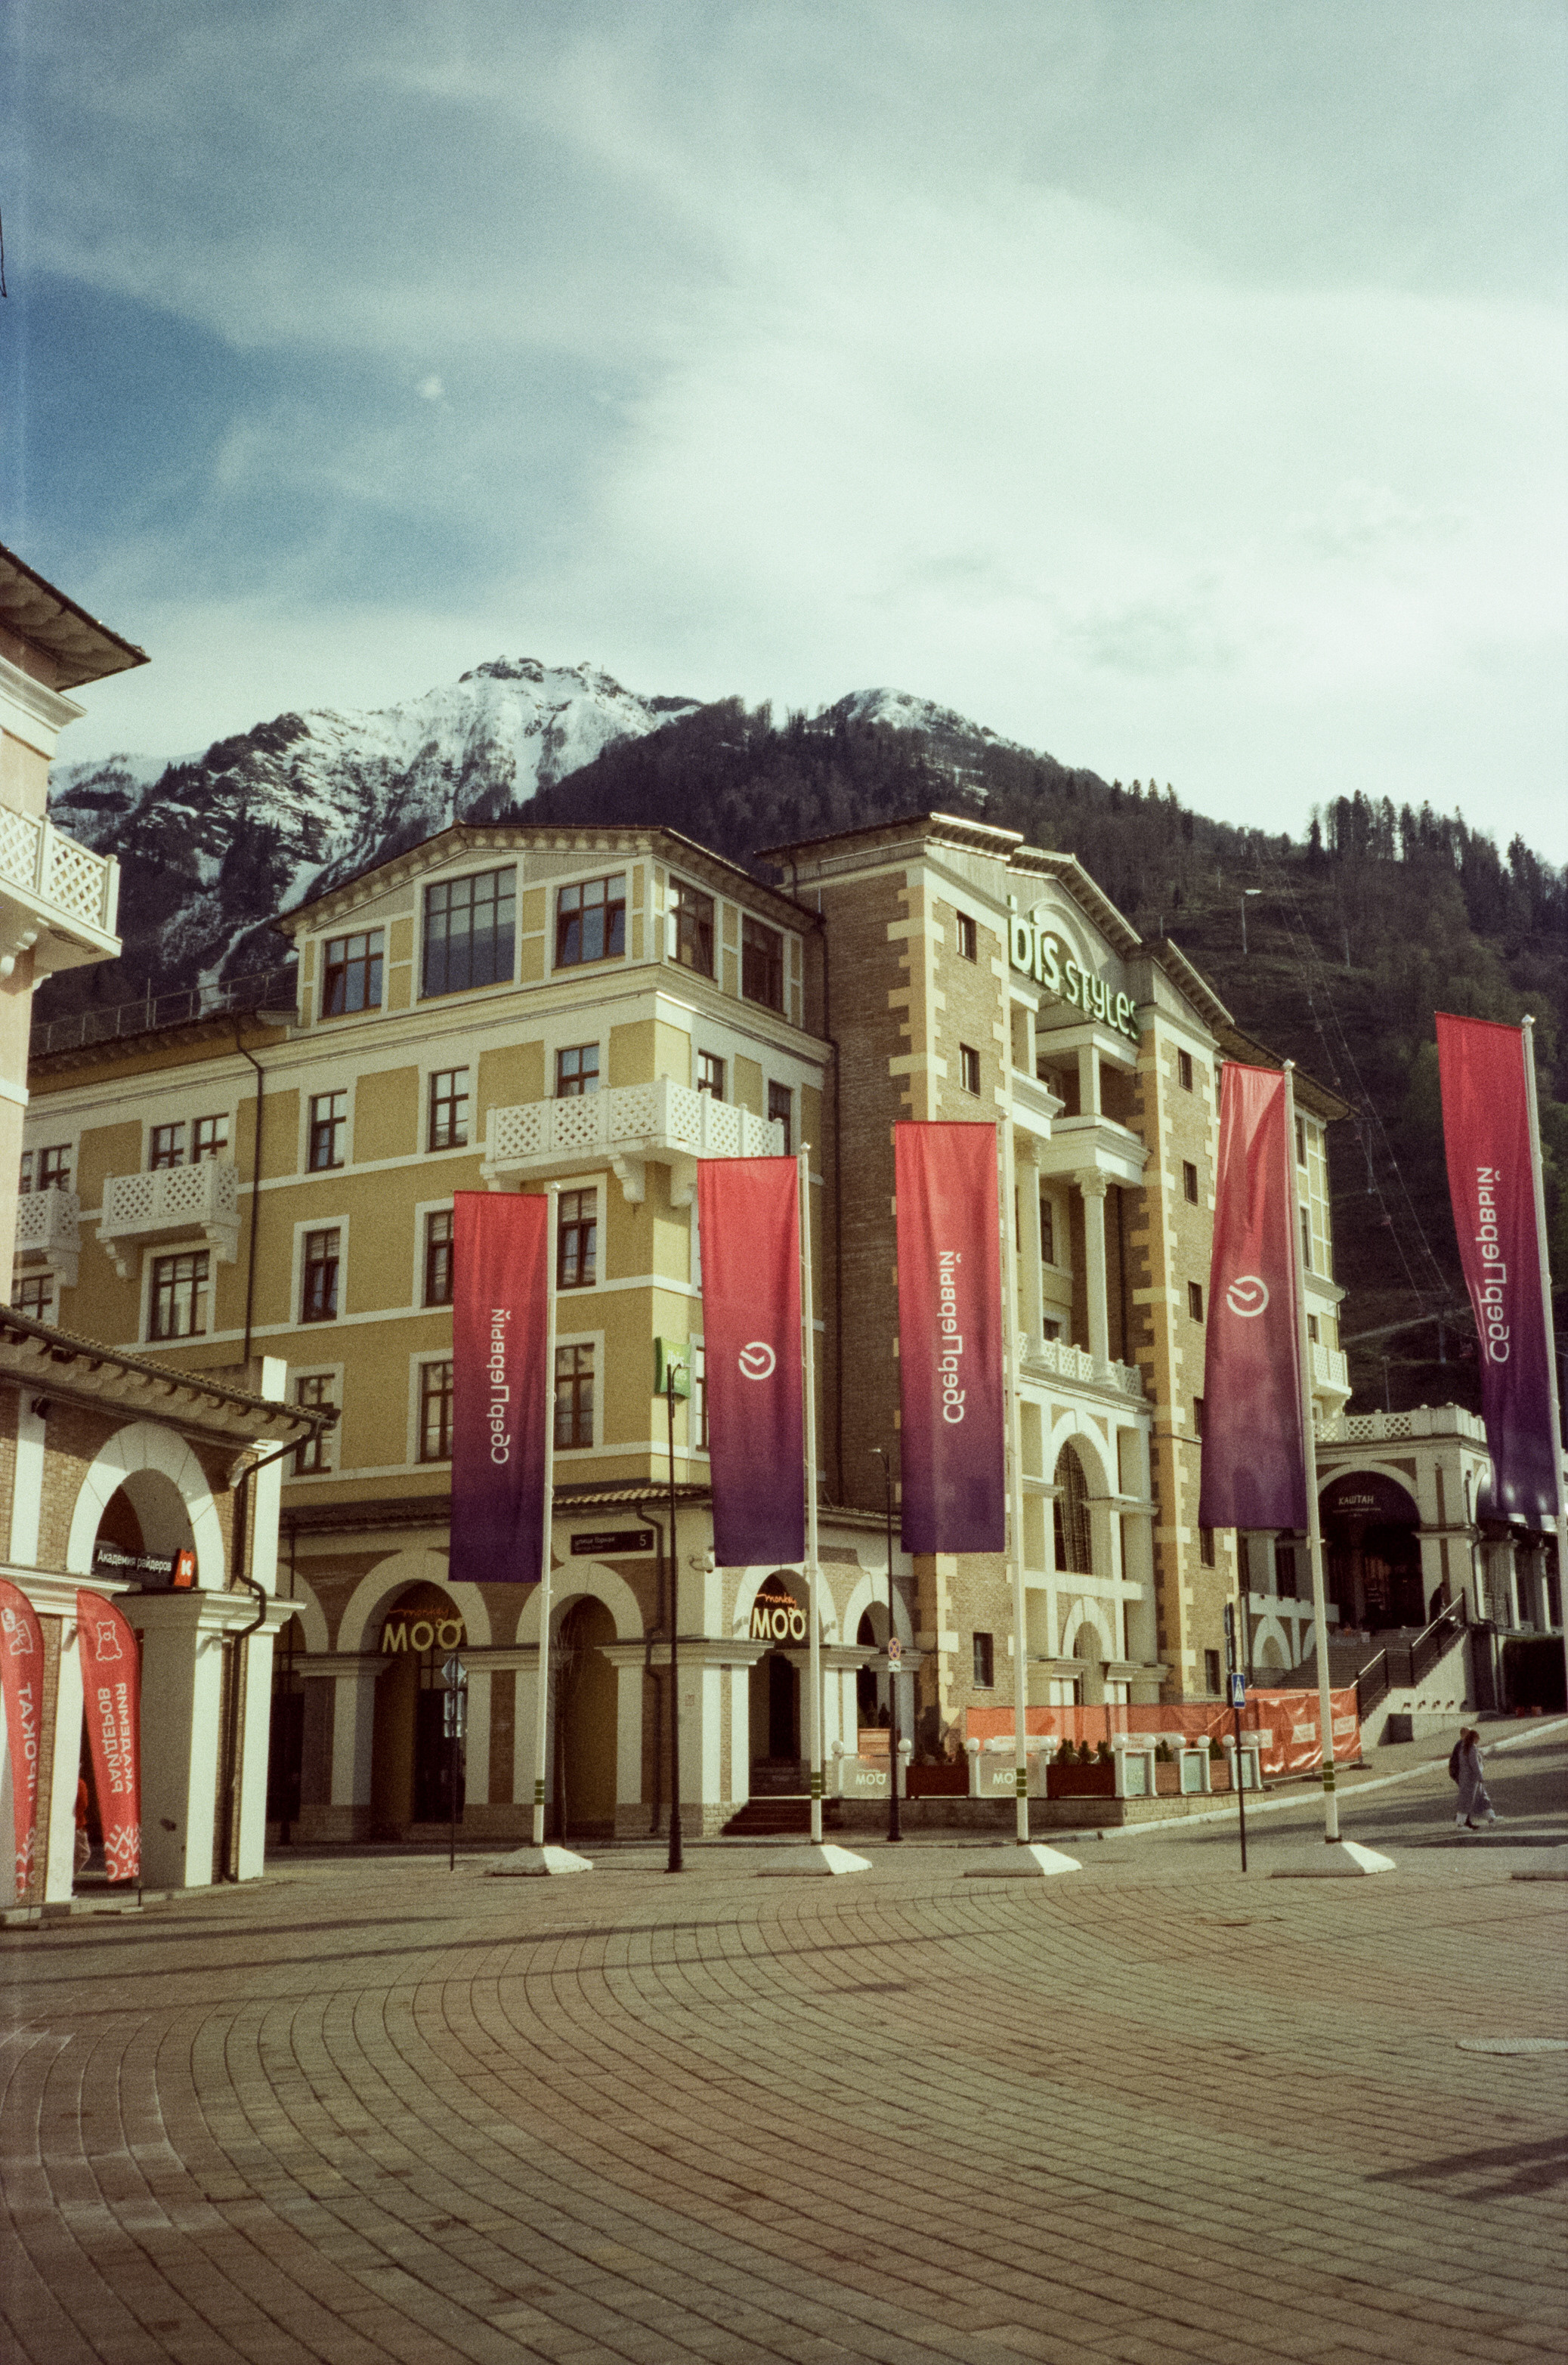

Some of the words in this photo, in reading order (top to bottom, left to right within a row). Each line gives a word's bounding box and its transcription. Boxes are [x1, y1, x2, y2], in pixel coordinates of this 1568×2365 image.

[1338, 1495, 1375, 1506] КАШТАН
[639, 1535, 646, 1547] 5
[97, 1549, 136, 1567] Академия
[137, 1556, 172, 1574] райдеров
[752, 1606, 807, 1640] MOO
[382, 1618, 464, 1653] MOO
[855, 1773, 886, 1785] MOO
[992, 1772, 1017, 1785] MO
